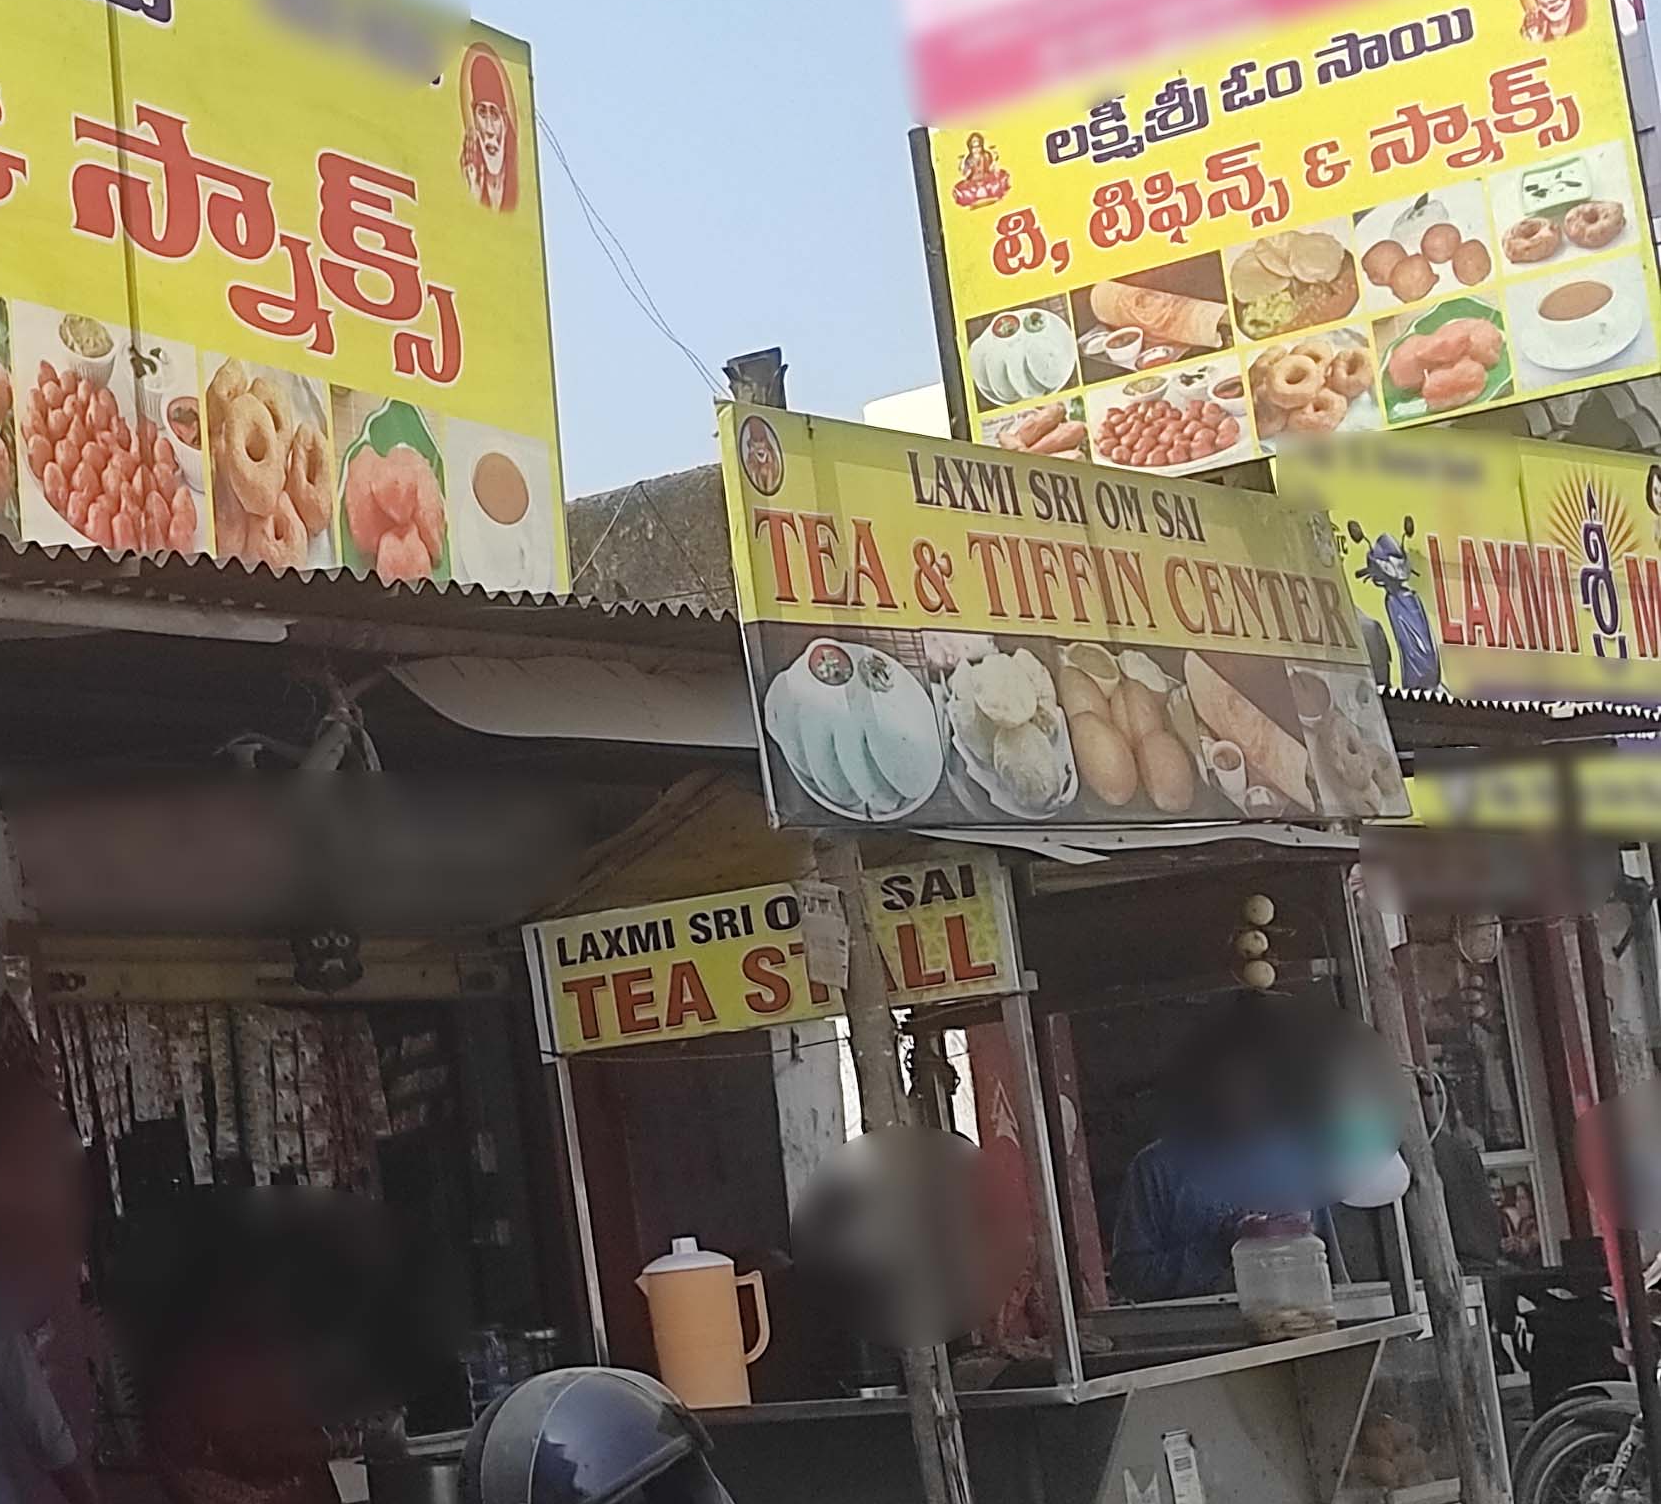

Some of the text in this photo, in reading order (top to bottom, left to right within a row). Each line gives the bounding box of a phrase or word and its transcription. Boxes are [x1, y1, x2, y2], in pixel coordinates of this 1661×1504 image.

[1303, 140, 1352, 189] &
[907, 451, 1206, 543] LAXMI SRI OM SAI
[754, 507, 1360, 650] TEA & TIFFIN CENTER
[1426, 535, 1580, 655] LAXMI
[557, 918, 676, 968] LAXMI
[689, 904, 755, 946] SRI
[881, 863, 978, 913] SAI
[562, 913, 999, 1042] TEA SLL
